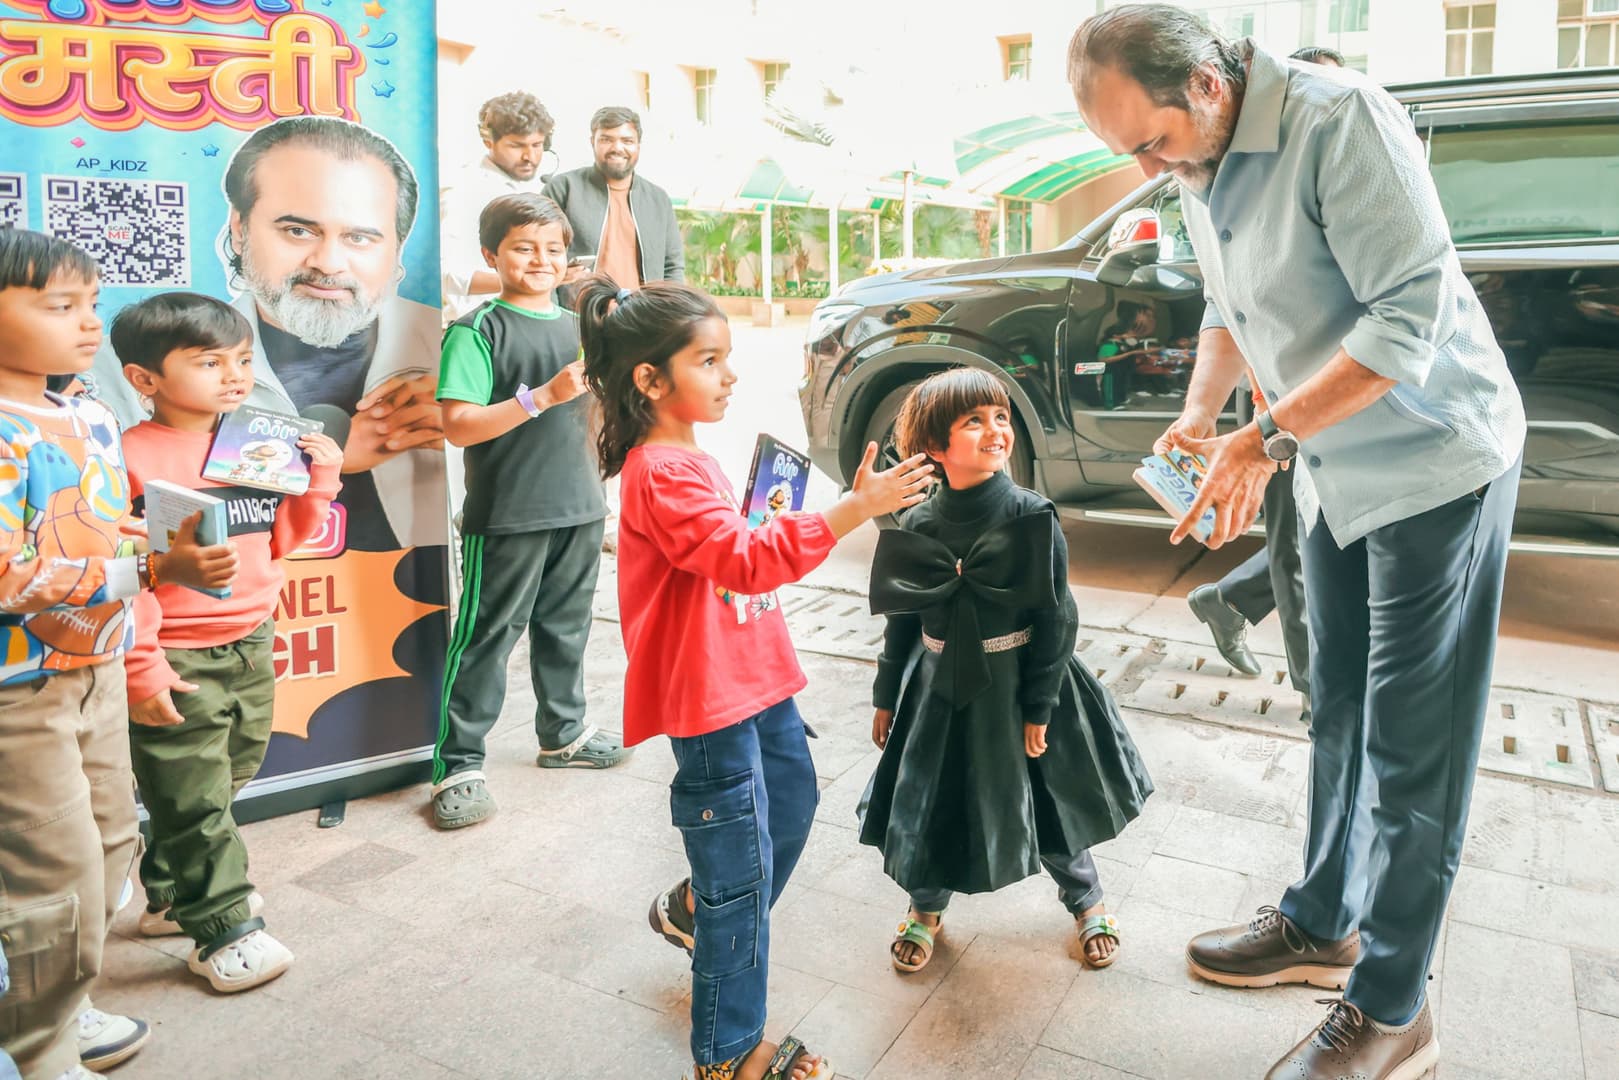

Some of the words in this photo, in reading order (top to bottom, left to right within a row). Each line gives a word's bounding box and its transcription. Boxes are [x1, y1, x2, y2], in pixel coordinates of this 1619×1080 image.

[0, 12, 354, 117] मस्ती
[76, 157, 148, 172] AP_KIDZ
[108, 231, 130, 240] ME
[248, 416, 299, 440] Air
[772, 452, 799, 481] Air
